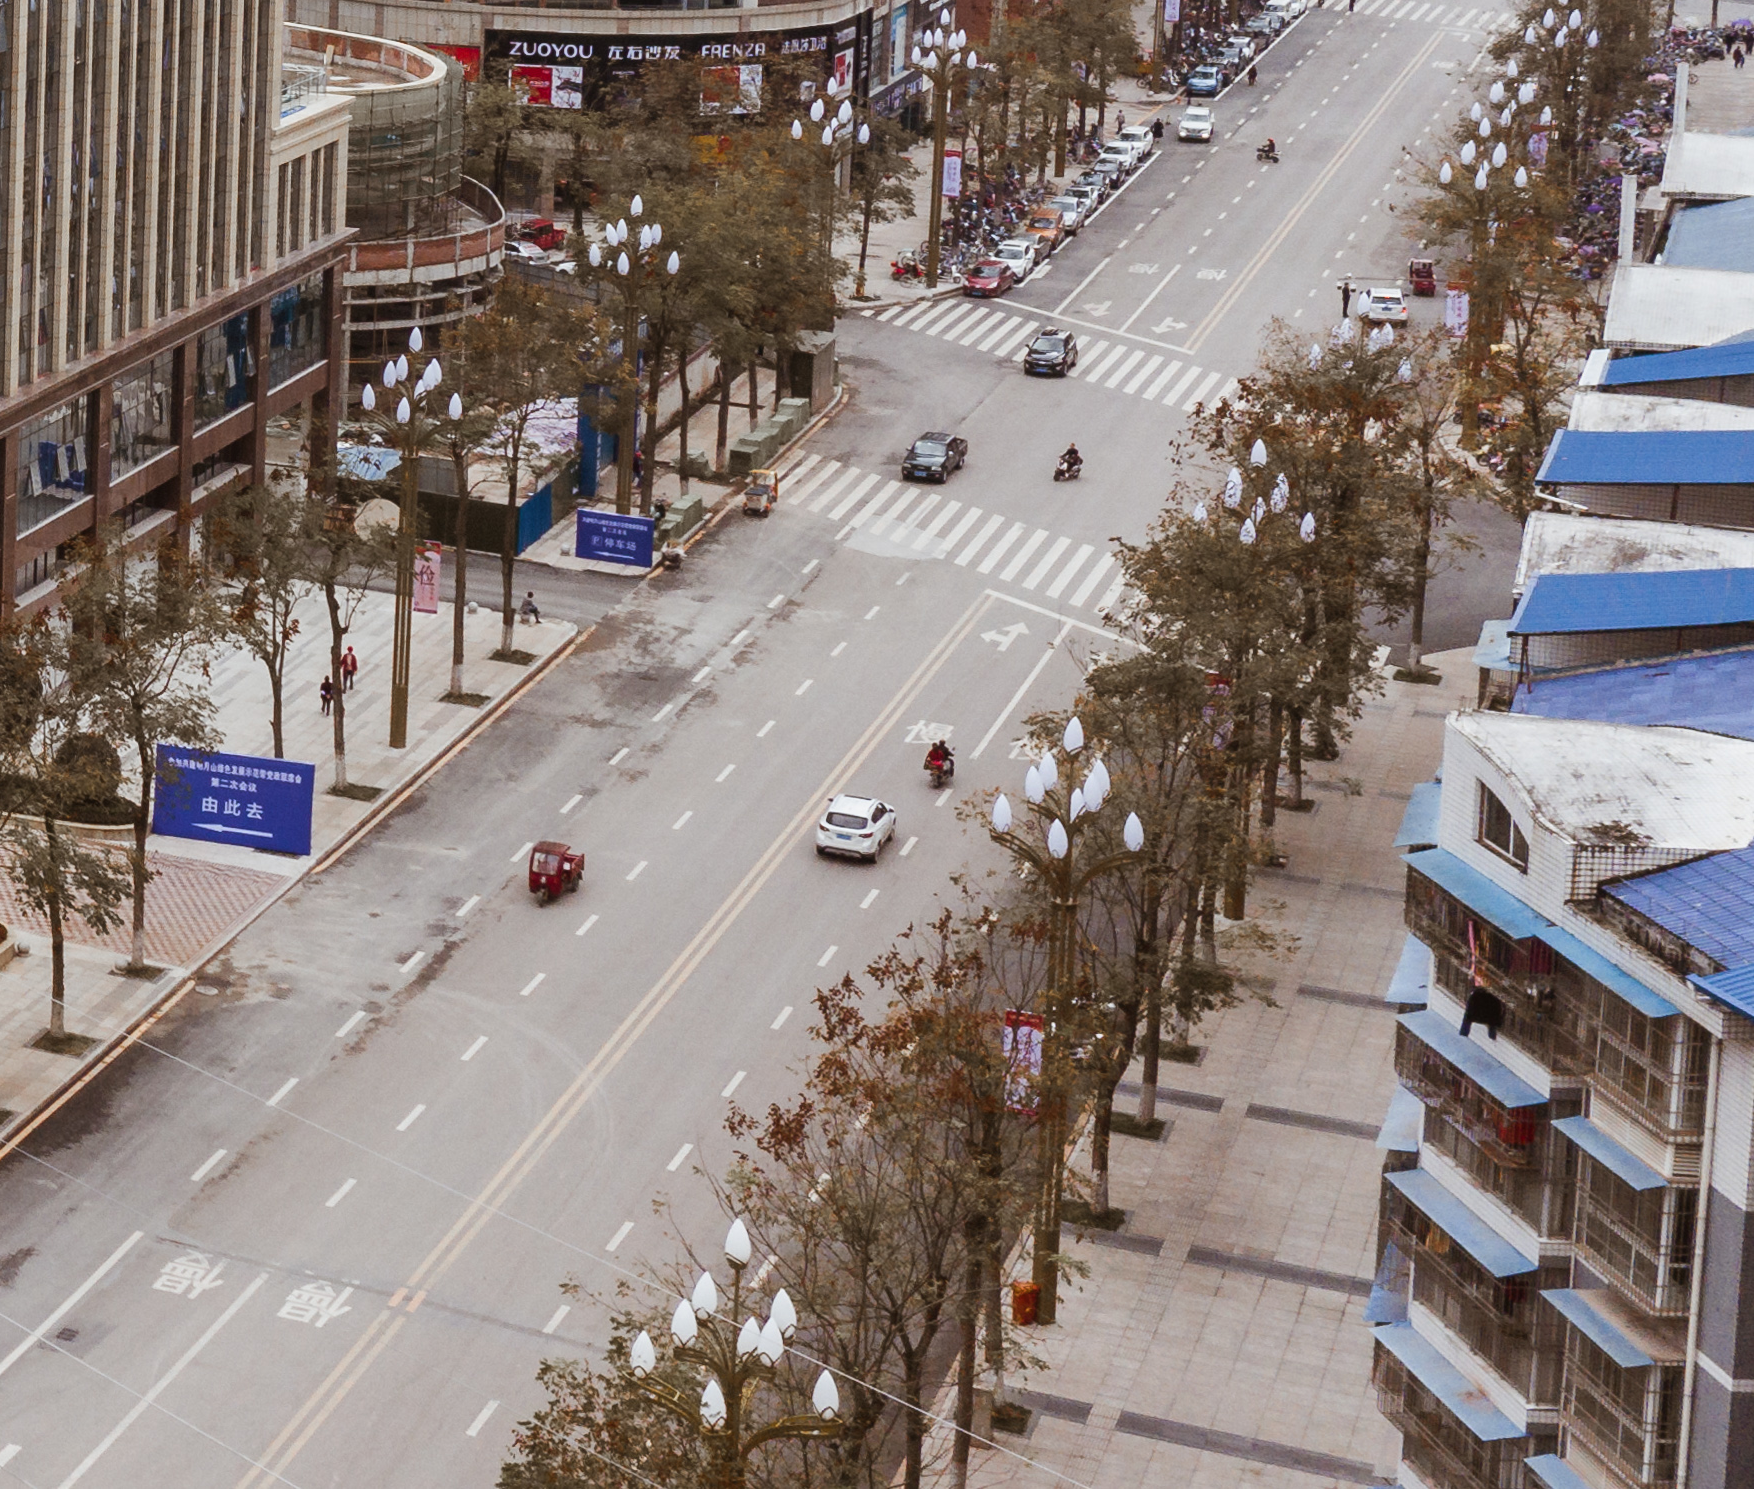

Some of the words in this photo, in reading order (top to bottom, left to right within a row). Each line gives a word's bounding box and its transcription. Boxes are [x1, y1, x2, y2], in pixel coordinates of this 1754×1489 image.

[508, 41, 594, 59] ZUOYOU
[608, 44, 681, 60] 左右沙发
[700, 42, 766, 59] FAENZA
[210, 776, 258, 793] 第二次会议
[201, 796, 264, 820] 由此去
